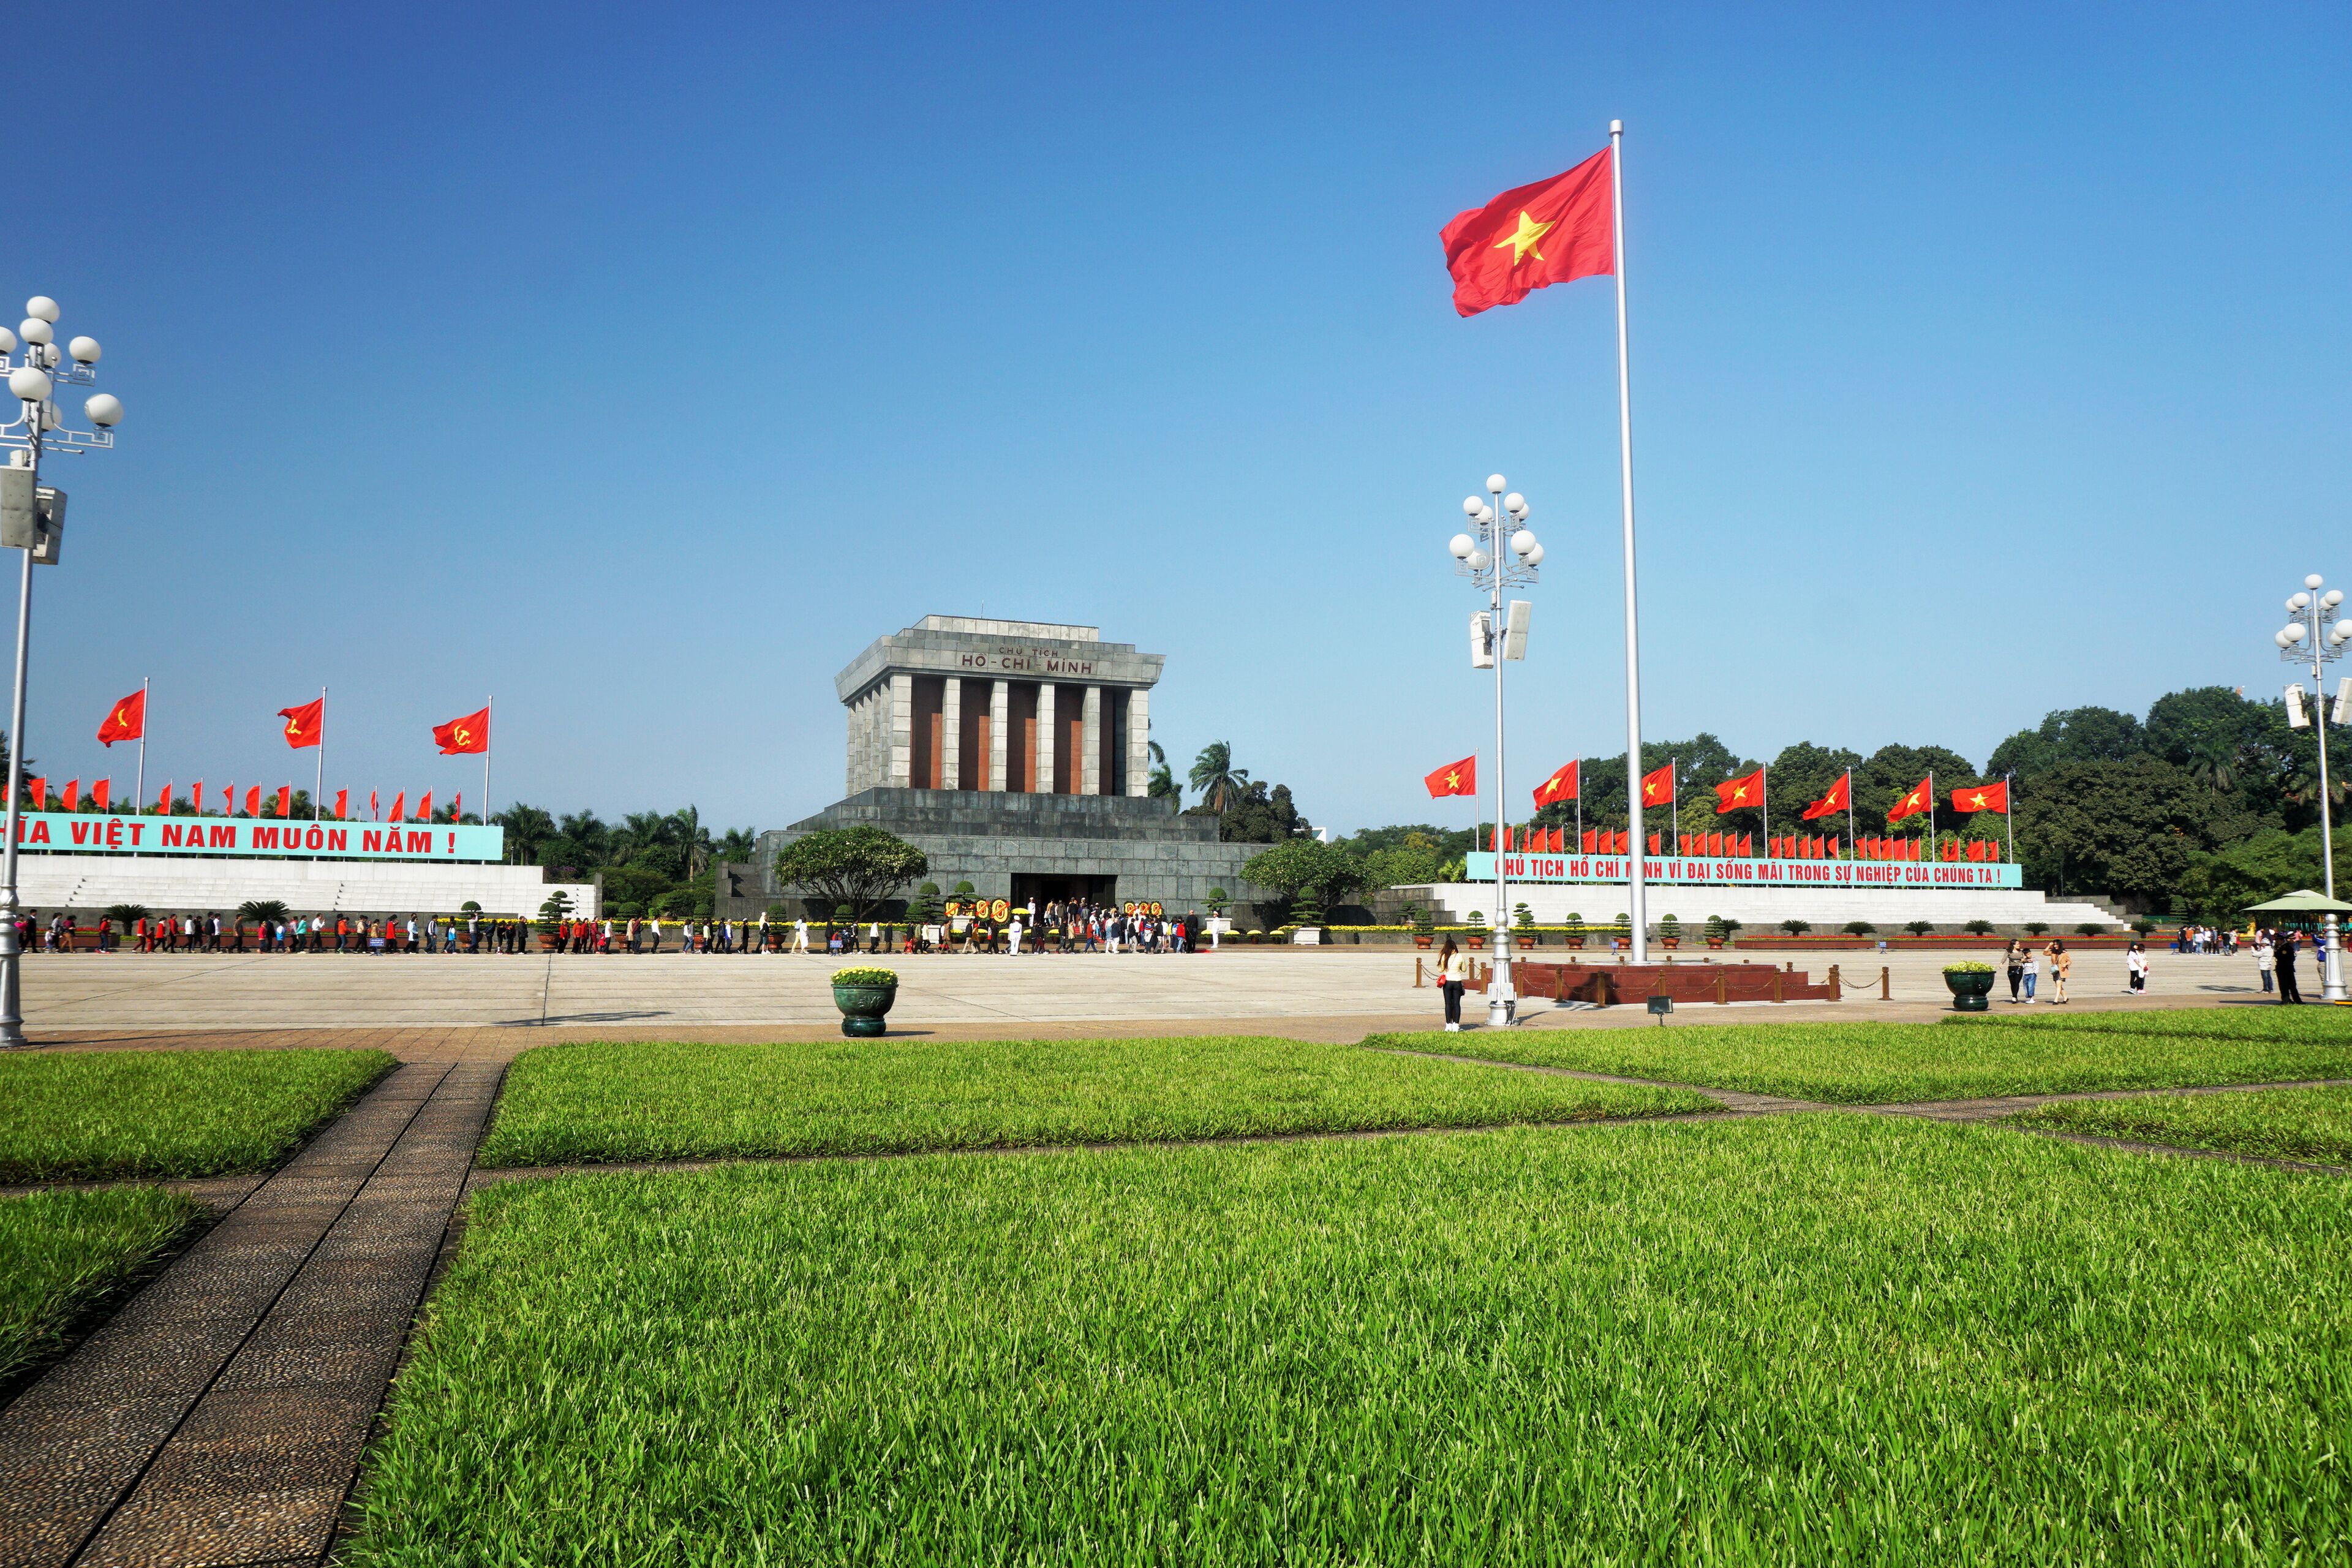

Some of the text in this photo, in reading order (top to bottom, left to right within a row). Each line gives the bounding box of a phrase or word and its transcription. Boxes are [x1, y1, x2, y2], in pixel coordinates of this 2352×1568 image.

[0, 816, 50, 843] ĨA
[71, 818, 145, 850] VIỆT
[162, 825, 236, 848] NAM
[252, 824, 347, 851] MUÔN
[363, 826, 432, 853] NĂM
[1531, 859, 1564, 880] TỊCH
[1570, 856, 1589, 877] HỒ
[1596, 858, 1619, 878] CHÍ
[1626, 861, 1662, 878] NH
[1668, 859, 1681, 879] VĨ
[1687, 862, 1710, 882] ĐẠI
[1716, 859, 1752, 880] SỐNG
[1758, 861, 1783, 880] MÃI
[1789, 865, 1830, 881] TRONG
[1836, 864, 1852, 884] SỰ
[1856, 864, 1901, 884] NGHIỆP
[1905, 862, 1929, 882] CỦA
[1934, 865, 1973, 883] CHÚNG
[1978, 868, 1992, 883] TA
